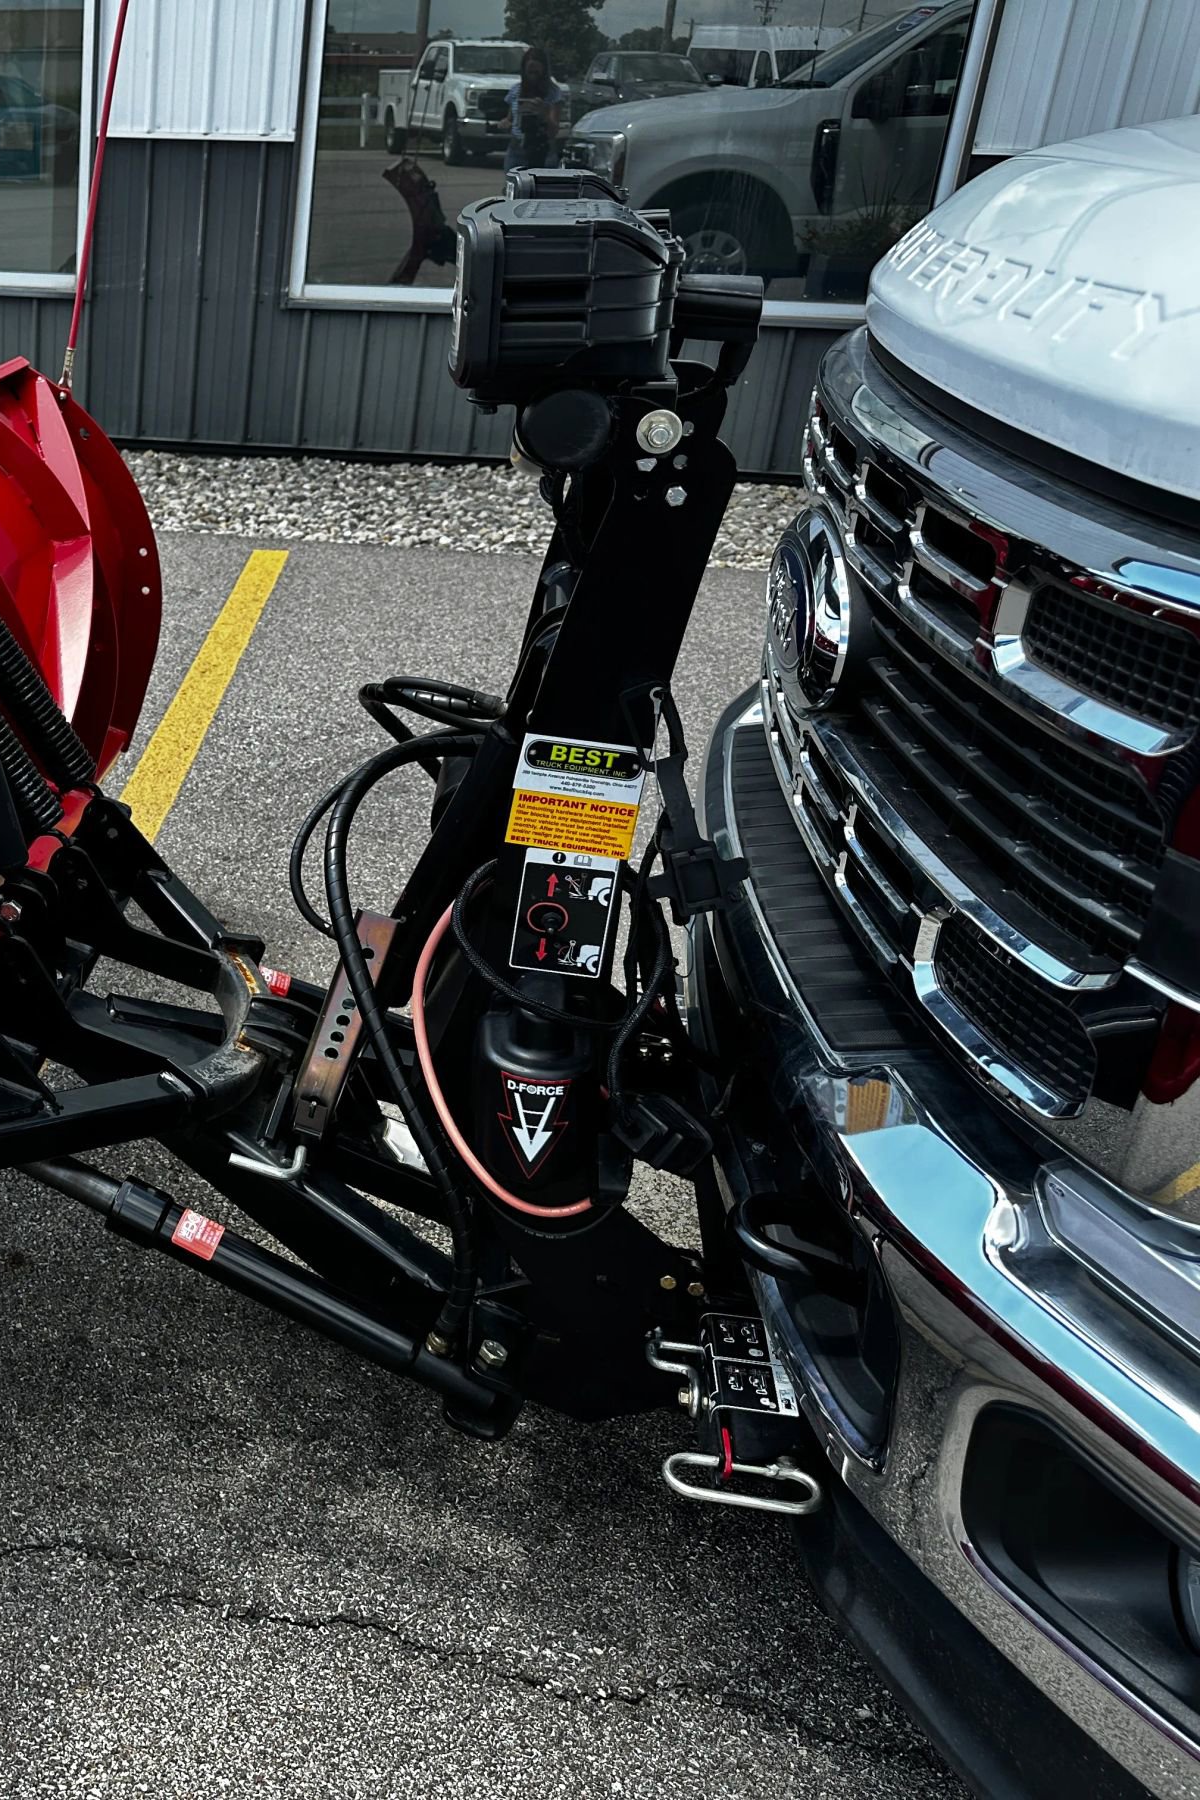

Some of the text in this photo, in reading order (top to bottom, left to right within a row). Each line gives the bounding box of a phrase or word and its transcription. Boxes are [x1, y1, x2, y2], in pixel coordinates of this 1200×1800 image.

[956, 257, 1165, 360] DUTY
[535, 759, 562, 768] TRUCK
[549, 744, 620, 769] BEST
[518, 793, 635, 817] IMPORTANT NOTICE
[526, 805, 554, 813] mounting
[555, 809, 583, 817] hardware
[583, 813, 611, 821] including
[569, 817, 601, 826] equipment
[533, 838, 559, 846] TRUCK
[561, 843, 609, 854] EQUIPMENT,
[575, 837, 602, 845] specified
[507, 1080, 565, 1096] D-FORCE
